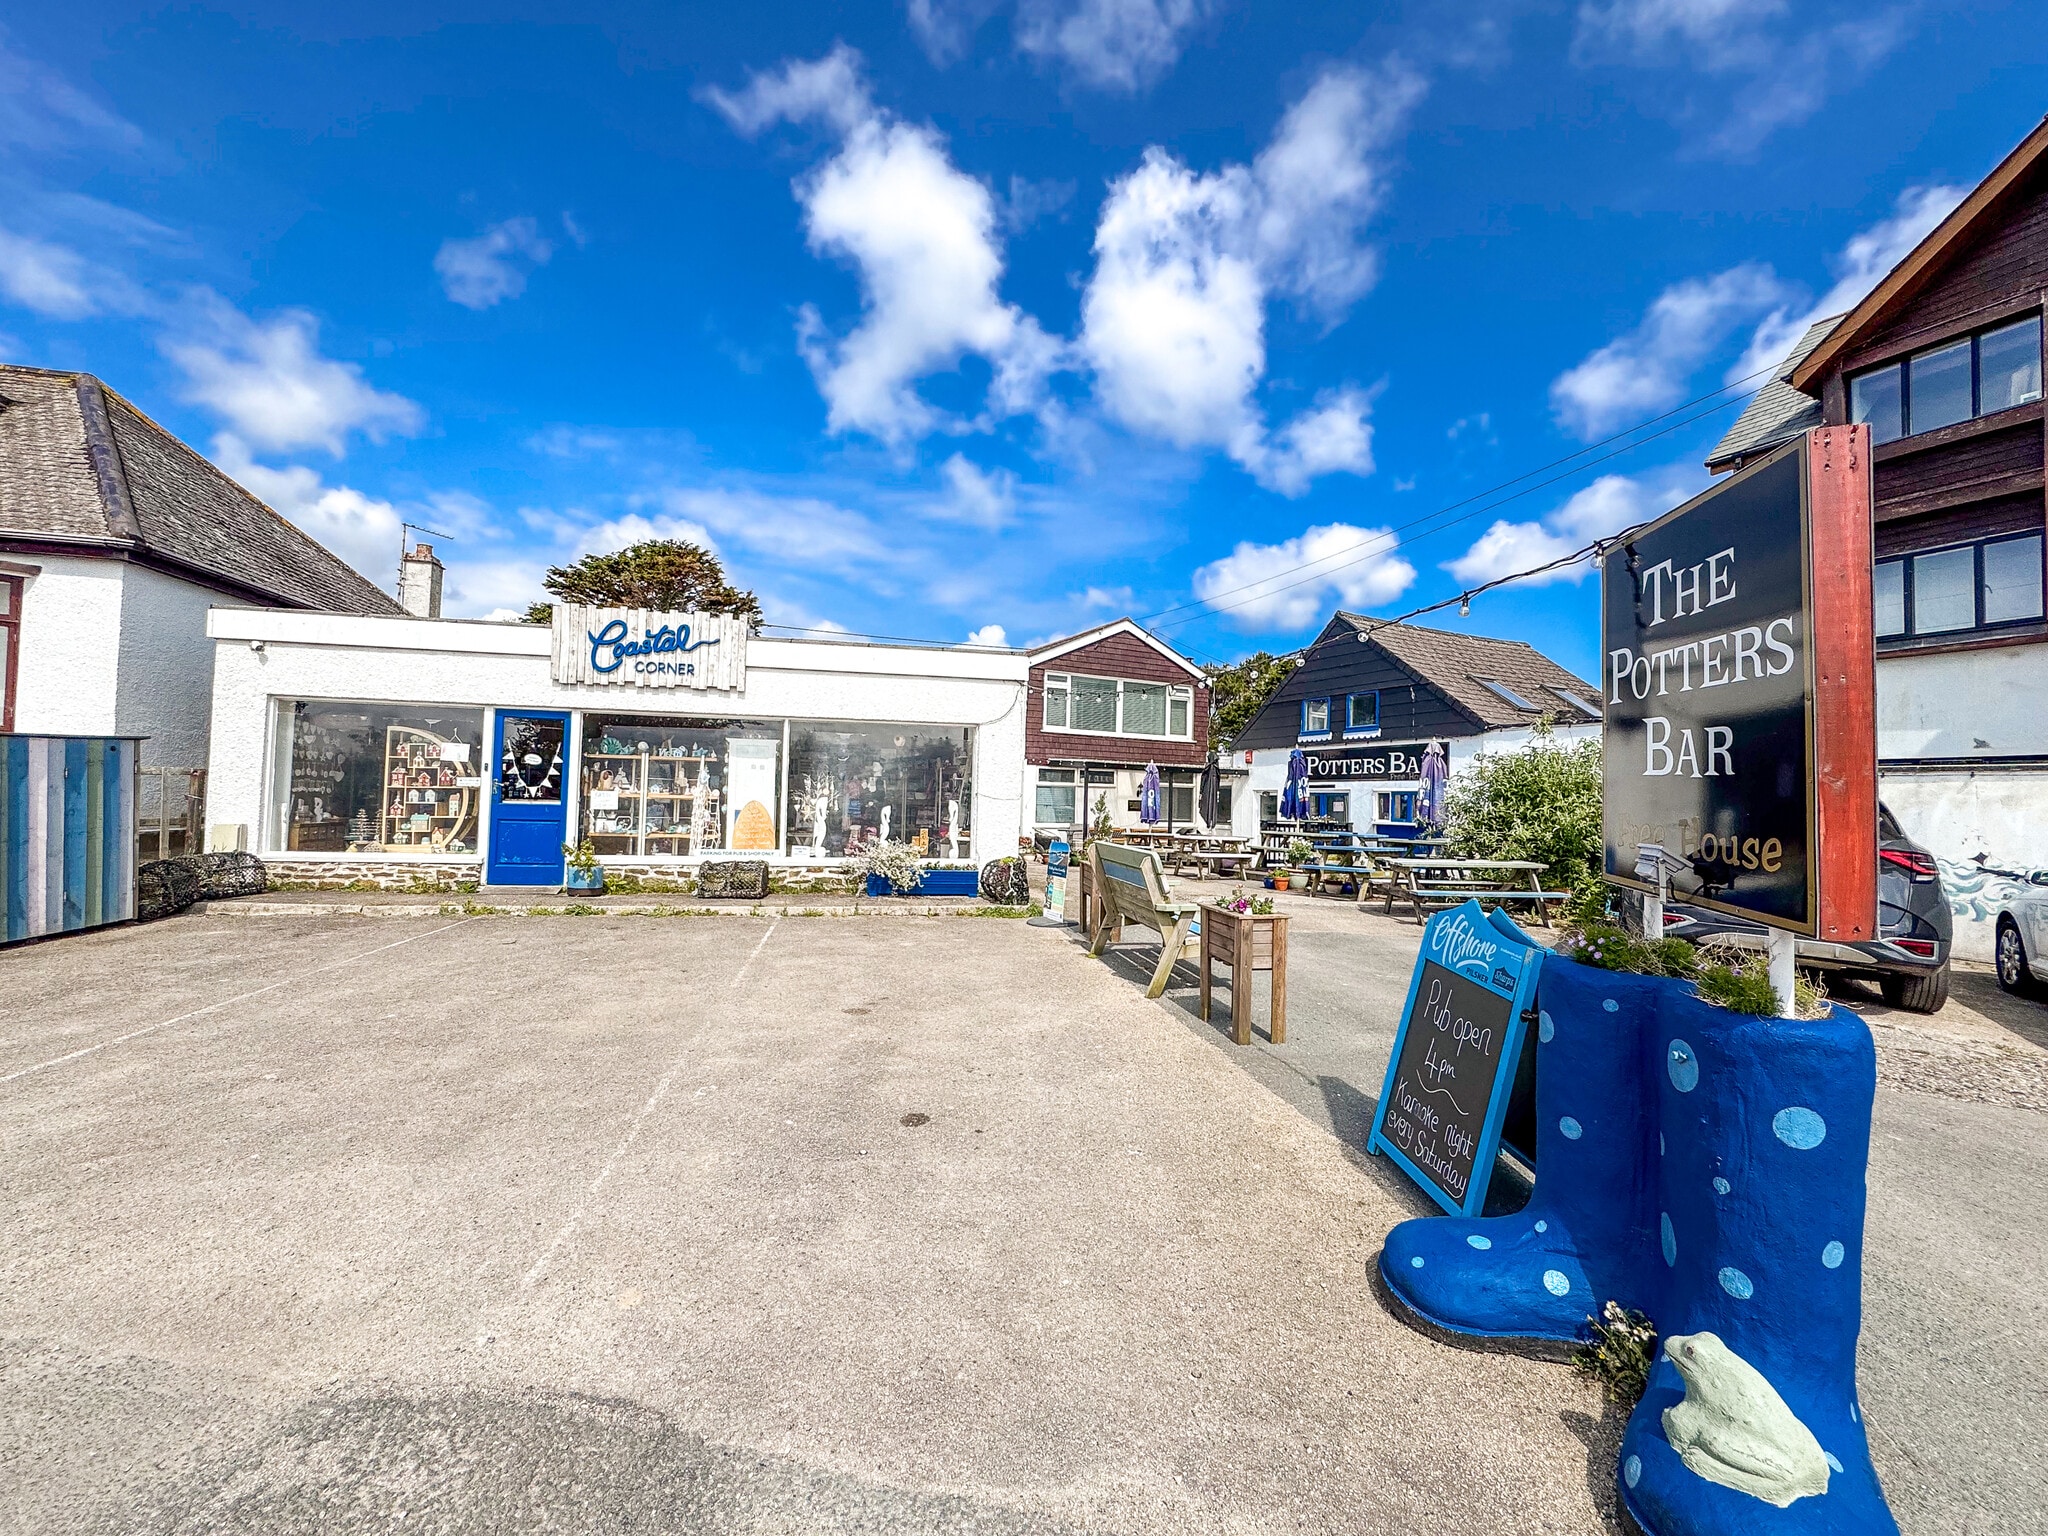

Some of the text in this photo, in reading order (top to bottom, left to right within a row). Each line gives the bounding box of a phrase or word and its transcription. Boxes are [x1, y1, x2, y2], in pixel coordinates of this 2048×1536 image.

[1642, 546, 1737, 627] THE
[588, 619, 720, 673] Coastal
[635, 661, 695, 676] CORNER
[1608, 616, 1795, 705] POTTERS
[1306, 752, 1421, 776] POTTERS BA
[1642, 716, 1736, 779] BAR
[1678, 816, 1784, 873] House
[1432, 913, 1498, 966] Offshore
[1465, 967, 1489, 985] PILSNER
[1423, 979, 1492, 1056] Pub open
[1387, 1109, 1468, 1199] every Saturday
[1444, 1123, 1475, 1160] night
